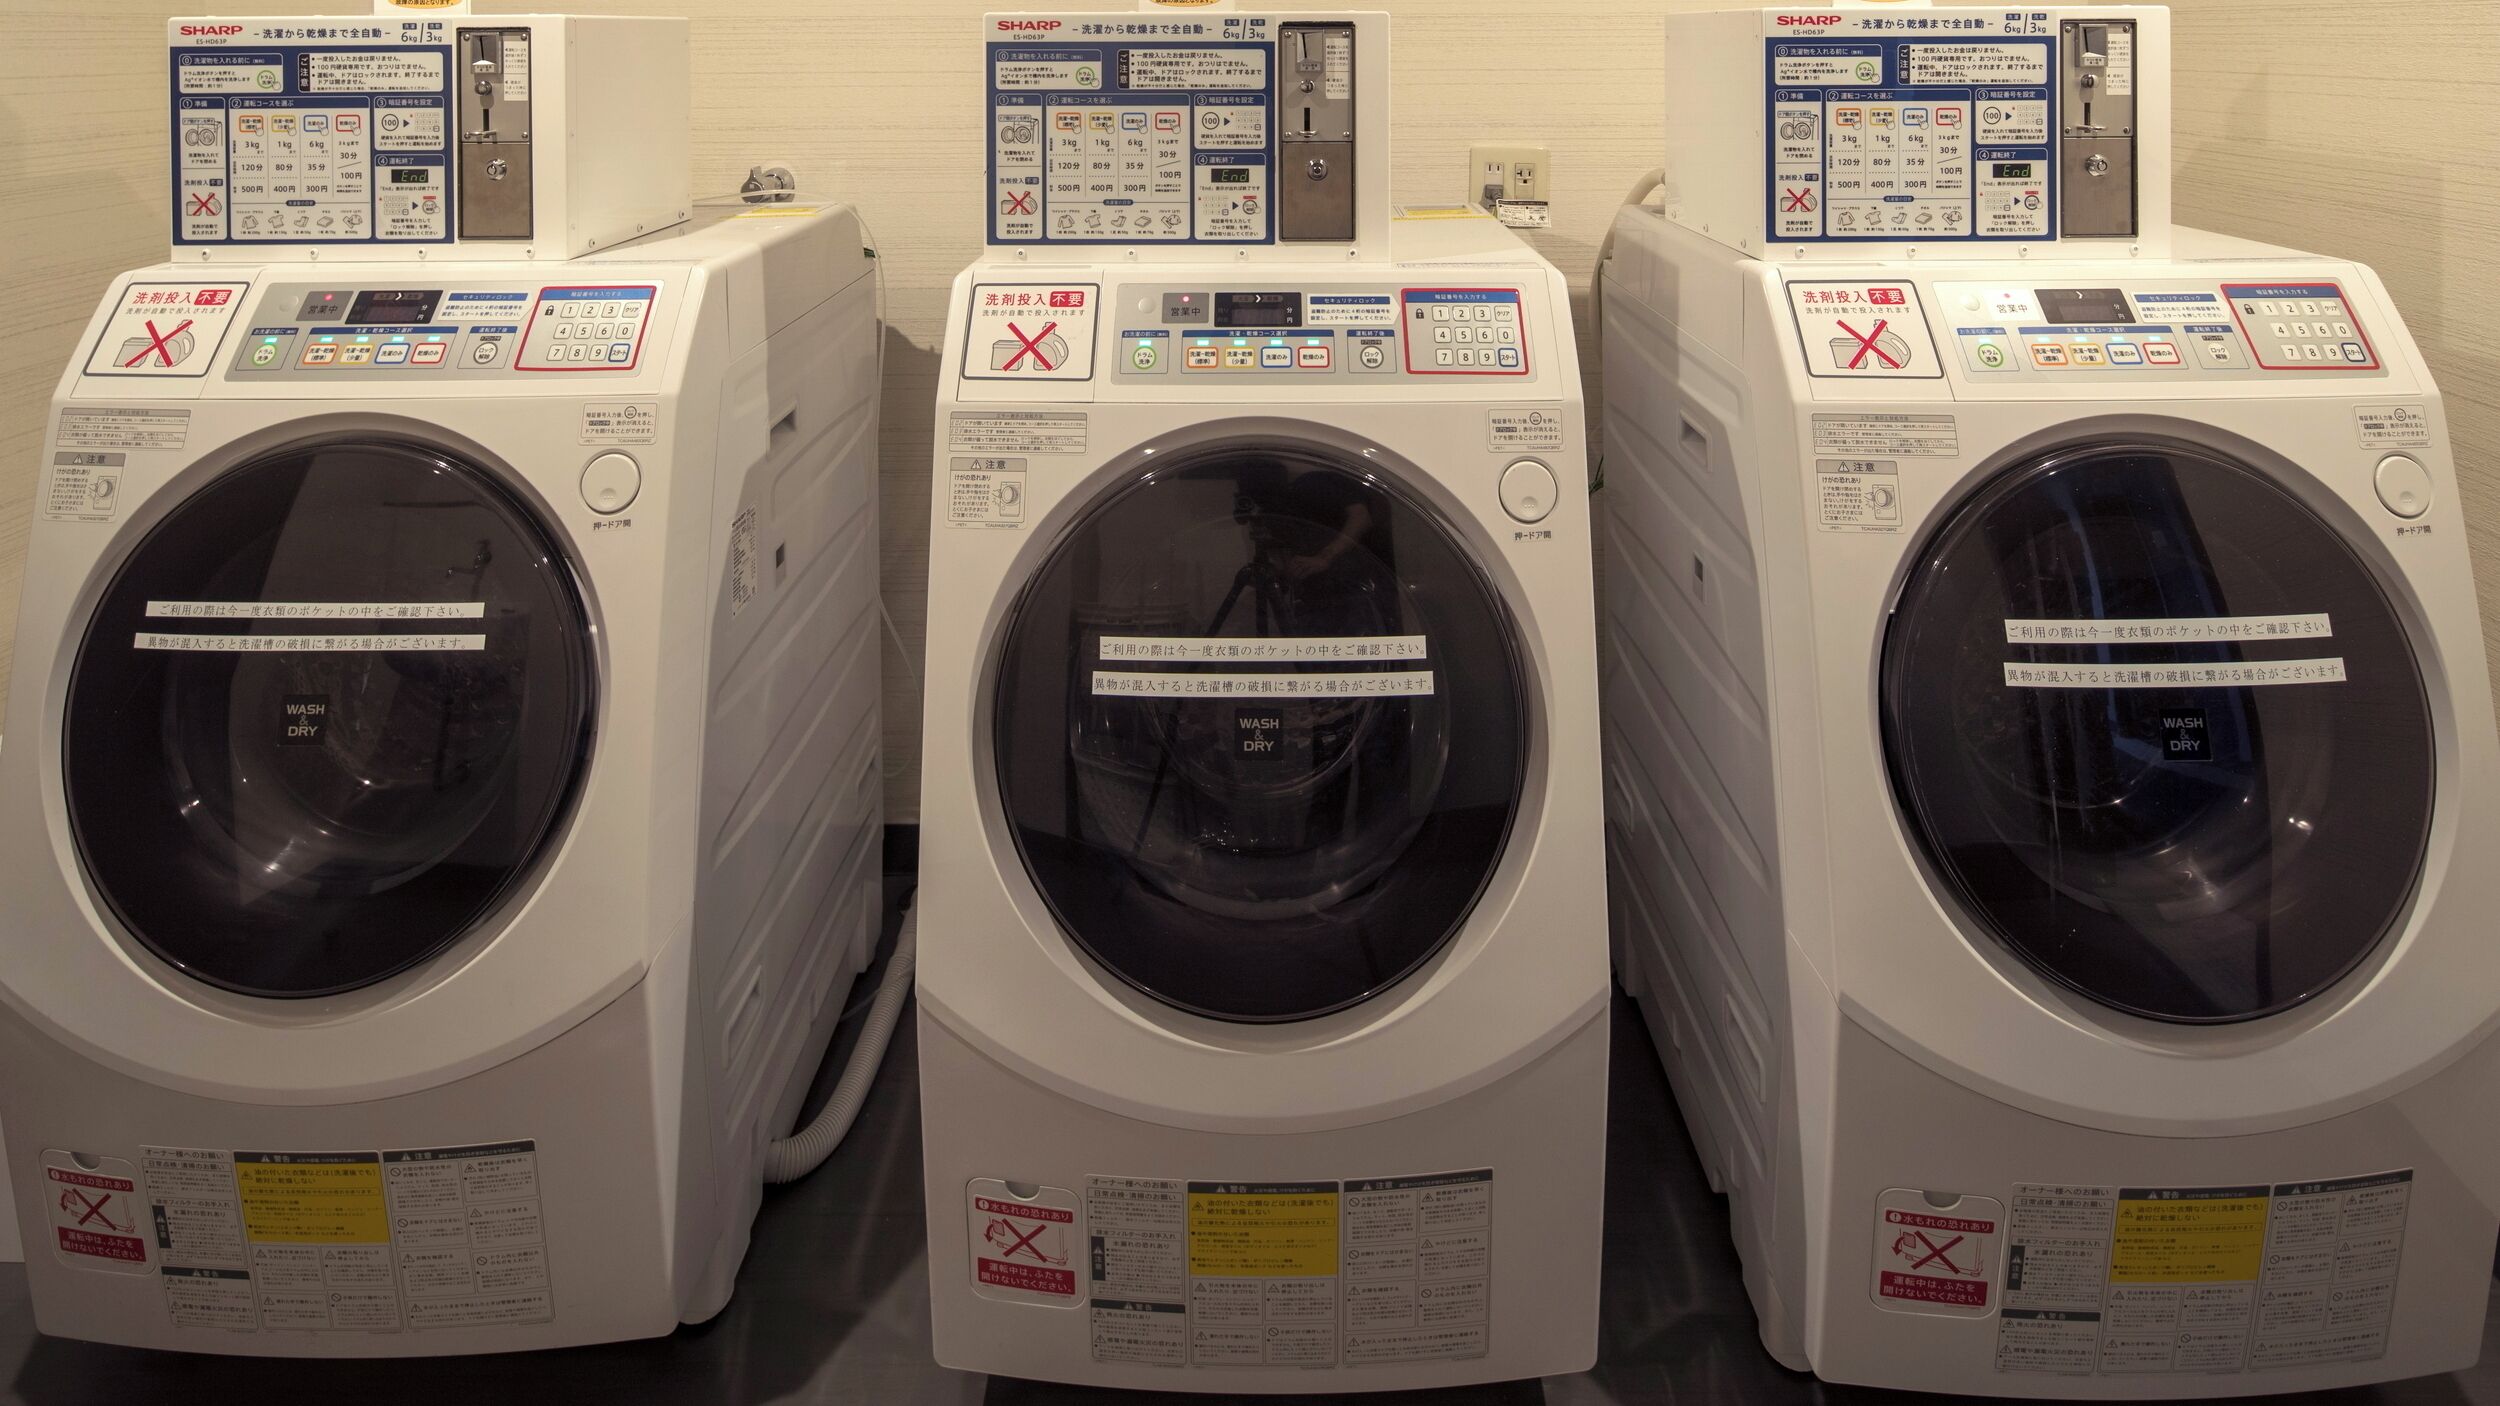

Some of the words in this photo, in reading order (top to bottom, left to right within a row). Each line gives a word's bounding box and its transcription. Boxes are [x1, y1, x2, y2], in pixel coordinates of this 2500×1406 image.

[998, 21, 1062, 30] SHARP
[1777, 16, 1841, 25] SHARP
[1862, 19, 1984, 29] 洗濯から乾燥まで全自動
[180, 25, 243, 36] SHARP
[262, 28, 382, 39] 洗濯から乾燥まで全自動
[1082, 24, 1203, 35] 洗濯から乾燥まで全自動
[1900, 49, 1908, 78] ご注意
[300, 58, 310, 87] ご注意
[1222, 170, 1248, 181] End
[2003, 165, 2030, 176] End
[401, 171, 427, 182] End
[133, 292, 191, 304] 洗剤投入
[199, 292, 228, 304] 不要
[986, 293, 1046, 306] 洗剤投入
[1052, 293, 1082, 305] 不要
[1803, 291, 1867, 303] 洗剤投入
[1870, 290, 1903, 303] 不要
[308, 305, 338, 314] 営業中
[1171, 308, 1200, 316] 営業中
[1997, 305, 2028, 313] 営業中
[160, 604, 464, 618] ご利用の際は今一度衣類のポケットの中をご確認下さい。
[2009, 622, 2331, 638] ご利用の際は今一度衣類のポケットの中をご確認下さい。
[1102, 643, 1425, 657] ご利用の際は今一度衣類のポケットの中をご確認下さい。
[287, 704, 325, 714] WASH
[299, 715, 309, 726] &
[1240, 719, 1280, 729] WASH
[2164, 718, 2203, 728] WASH
[288, 726, 318, 737] DRY
[1255, 729, 1264, 741] &
[2179, 729, 2190, 740] &
[1244, 741, 1273, 752] DRY
[2171, 740, 2200, 751] DRY
[146, 1150, 224, 1159] オーナー様へのお願い
[61, 1174, 130, 1189] 水もれの恐れあり
[1092, 1179, 1177, 1189] オーナー様へのお願い
[2020, 1187, 2109, 1196] オーナー様へのお願い
[991, 1204, 1069, 1220] 水もれの恐れあり
[1904, 1216, 1990, 1231] 水もれの恐れあり
[68, 1232, 133, 1248] 運転中は、ふたを
[62, 1241, 143, 1259] 開けないでください。
[989, 1264, 1064, 1280] 運転中は、ふたを
[982, 1272, 1070, 1292] 開けないでください。
[1893, 1276, 1976, 1292] 運転中は、ふたを
[1883, 1284, 1983, 1304] 開けないでください。
